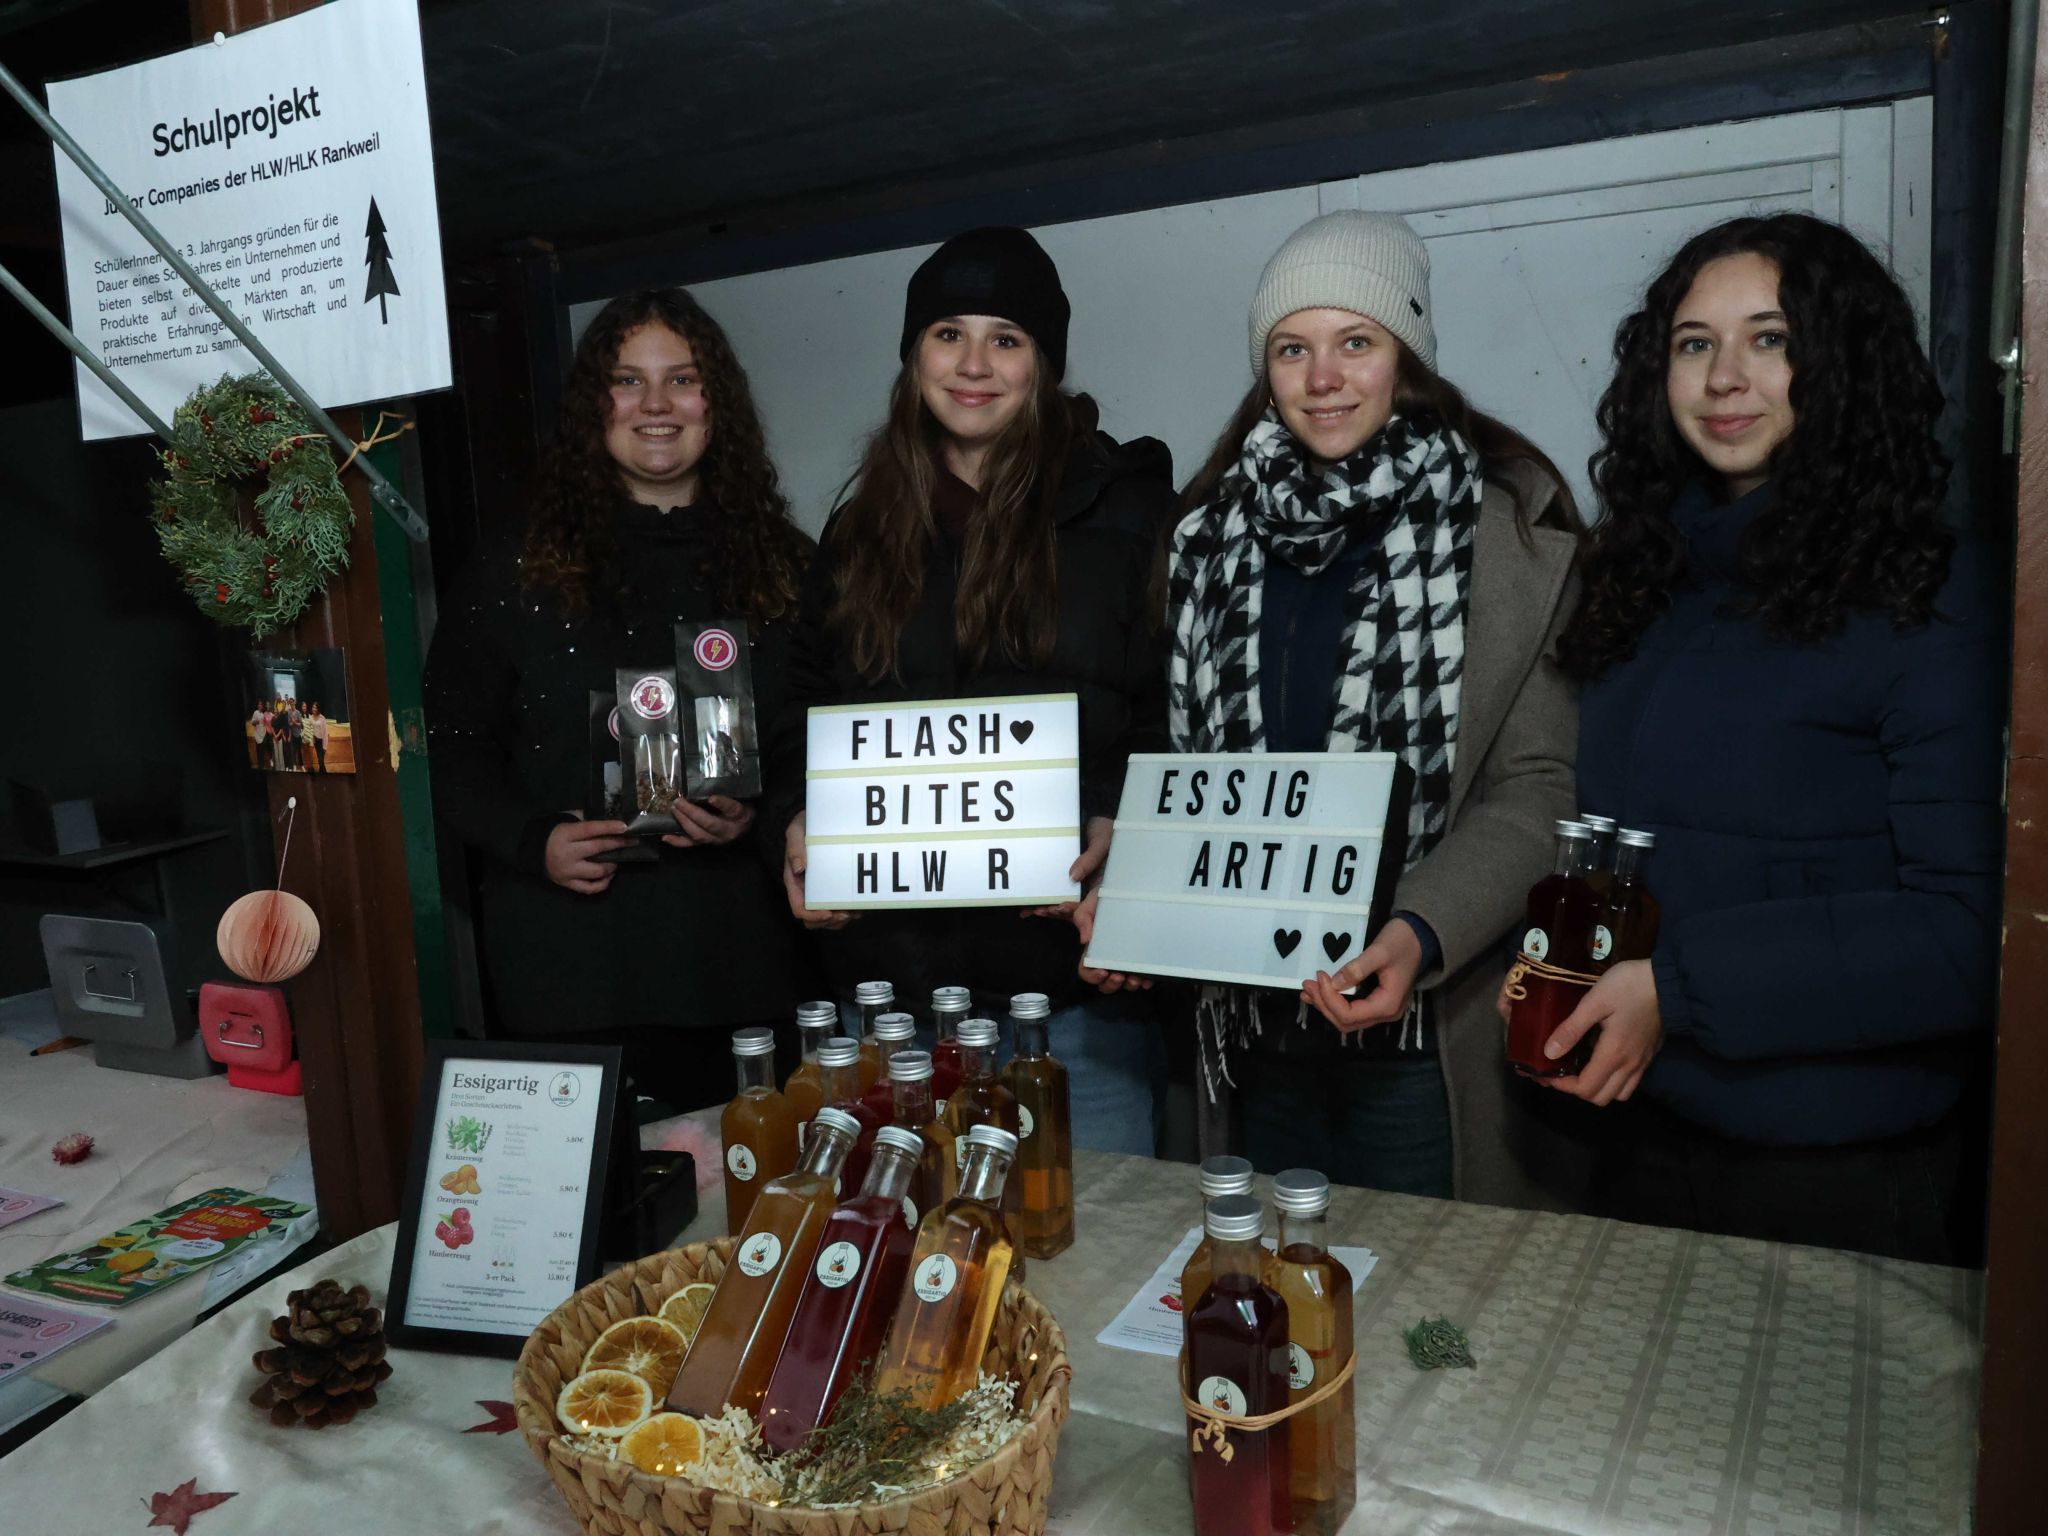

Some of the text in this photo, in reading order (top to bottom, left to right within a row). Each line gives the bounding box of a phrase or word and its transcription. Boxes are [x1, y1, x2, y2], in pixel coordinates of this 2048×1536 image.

[152, 86, 321, 157] Schulprojekt
[104, 132, 381, 215] Juor Companies der HLW/HLK Rankweil
[94, 253, 162, 274] SchülerInnen
[186, 244, 197, 257] 3.
[200, 233, 253, 254] Jahrgangs
[256, 223, 301, 246] gründen
[304, 218, 319, 231] für
[322, 213, 339, 228] die
[96, 280, 129, 293] Dauer
[132, 273, 160, 287] eines
[225, 256, 242, 269] ein
[245, 240, 317, 265] Unternehmen
[321, 233, 341, 250] und
[98, 255, 343, 312] bieten selbst enickelte und produzierte
[100, 277, 345, 331] Produkte auf diven Märkten an, um
[103, 331, 157, 353] praktische
[242, 313, 252, 326] in
[262, 301, 316, 323] Wirtschaft
[327, 294, 347, 311] und
[104, 338, 242, 368] Unternehmertum zu samm
[851, 713, 1001, 760] FLASH
[865, 779, 1015, 826] BITES
[1157, 769, 1310, 818] ESSIG
[857, 847, 1010, 894] HLW R
[1188, 840, 1358, 895] ARTIG
[452, 1073, 540, 1096] Essigartig
[500, 1273, 516, 1283] Pack
